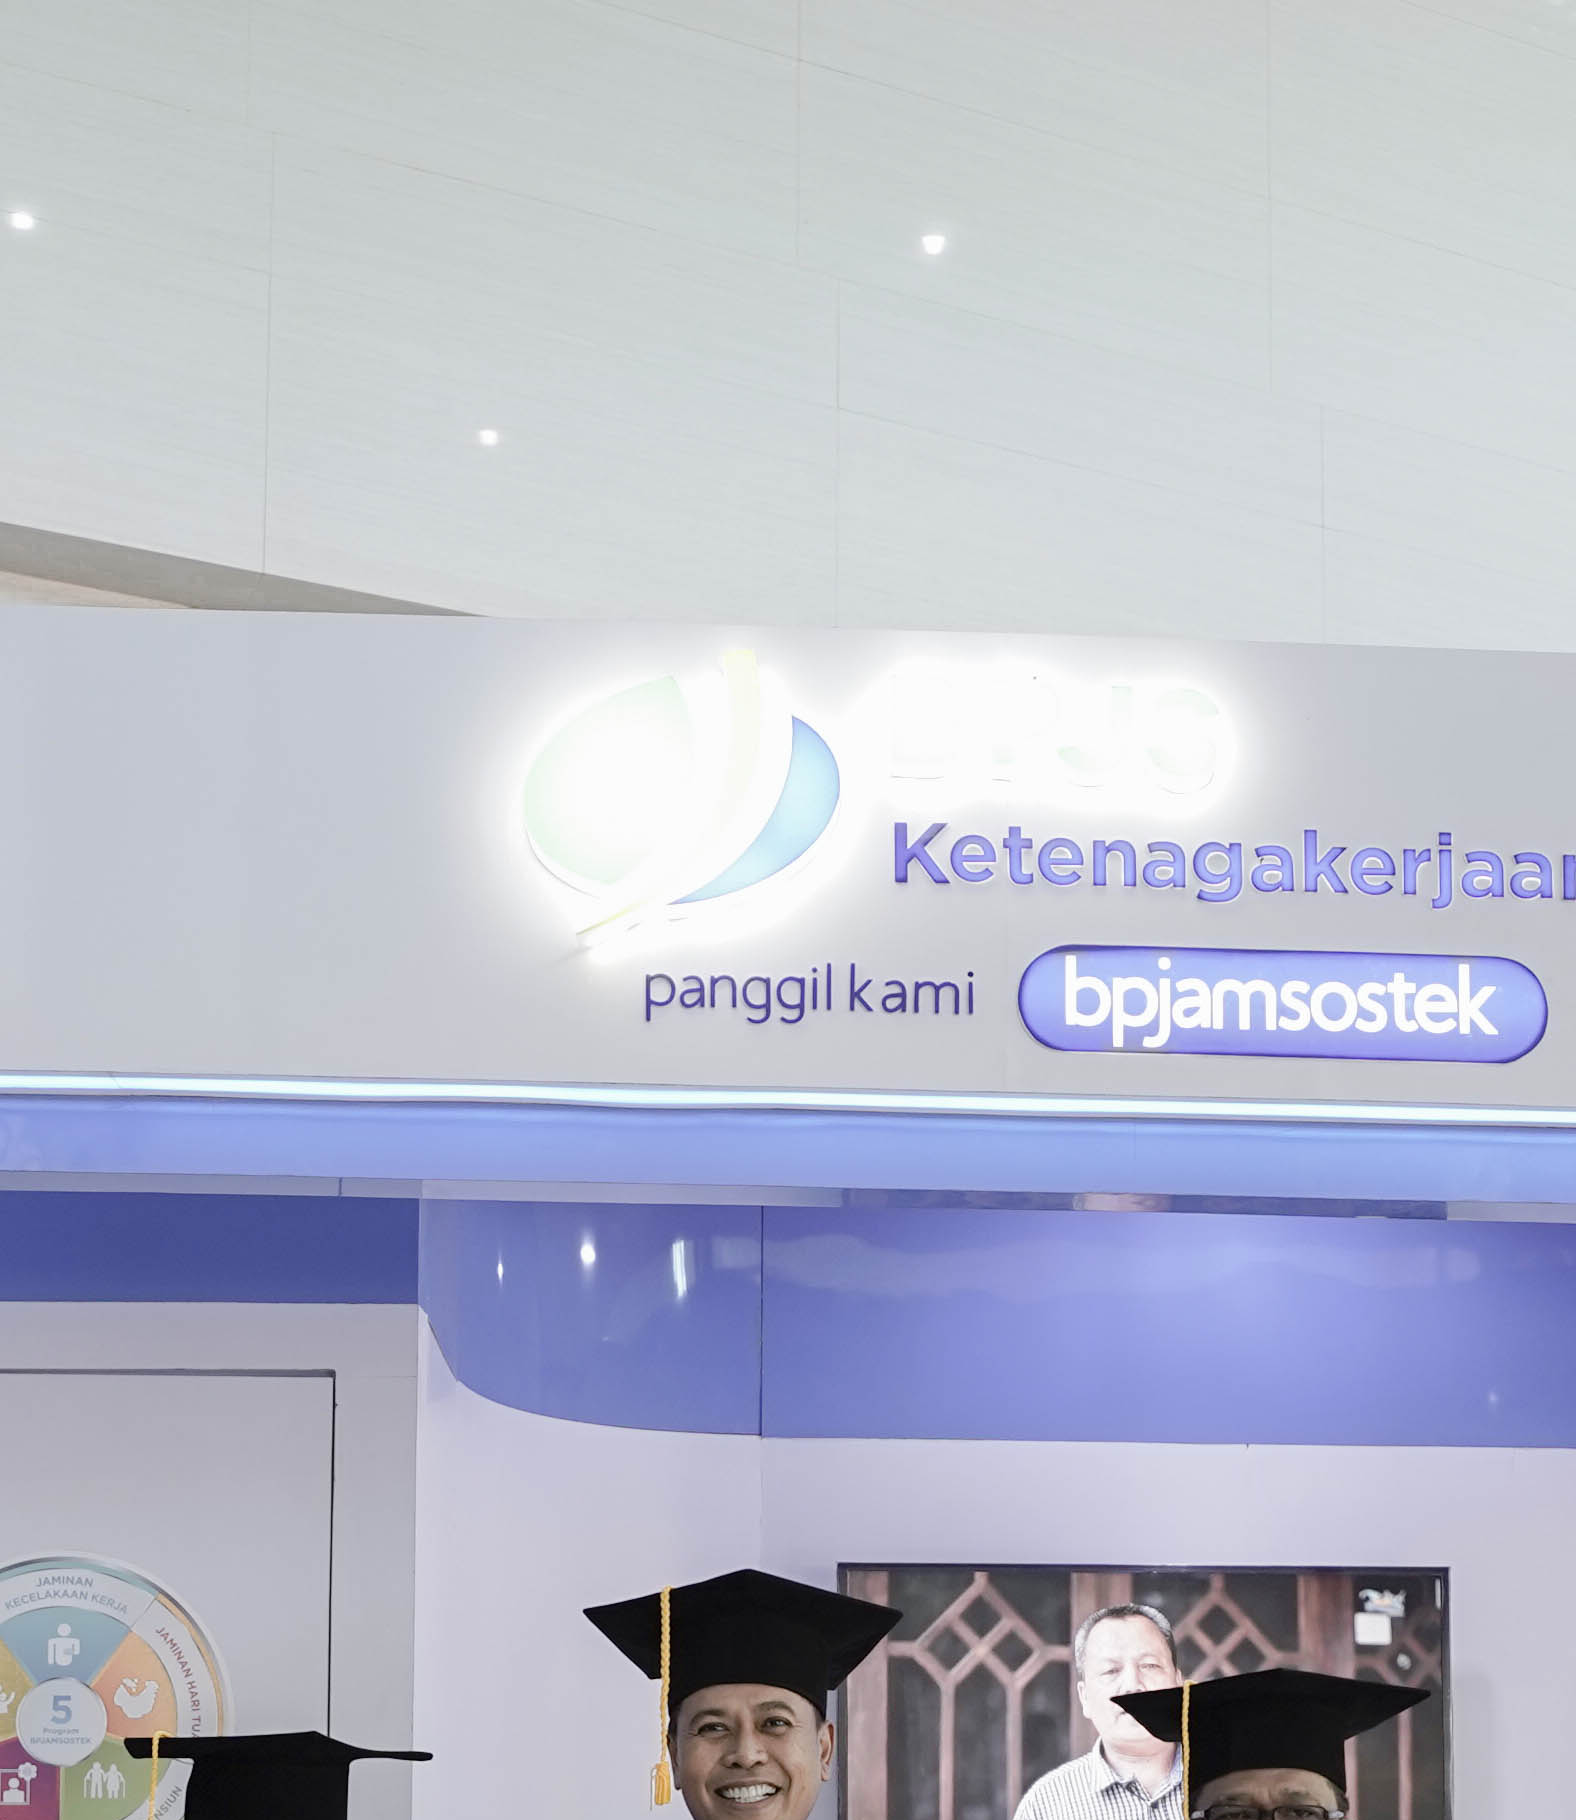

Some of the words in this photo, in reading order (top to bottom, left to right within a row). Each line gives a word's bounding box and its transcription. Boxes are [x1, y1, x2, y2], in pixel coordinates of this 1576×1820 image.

[643, 961, 831, 1025] panggil
[848, 963, 977, 1018] kami
[1063, 954, 1500, 1048] bpjamsostek
[35, 1575, 94, 1588] JAMINAN
[3, 1589, 89, 1611] KECELAKAAN
[89, 1593, 130, 1615] KERJA
[155, 1626, 193, 1679] JAMINAN
[186, 1680, 201, 1711] HARI
[50, 1695, 73, 1726] 5
